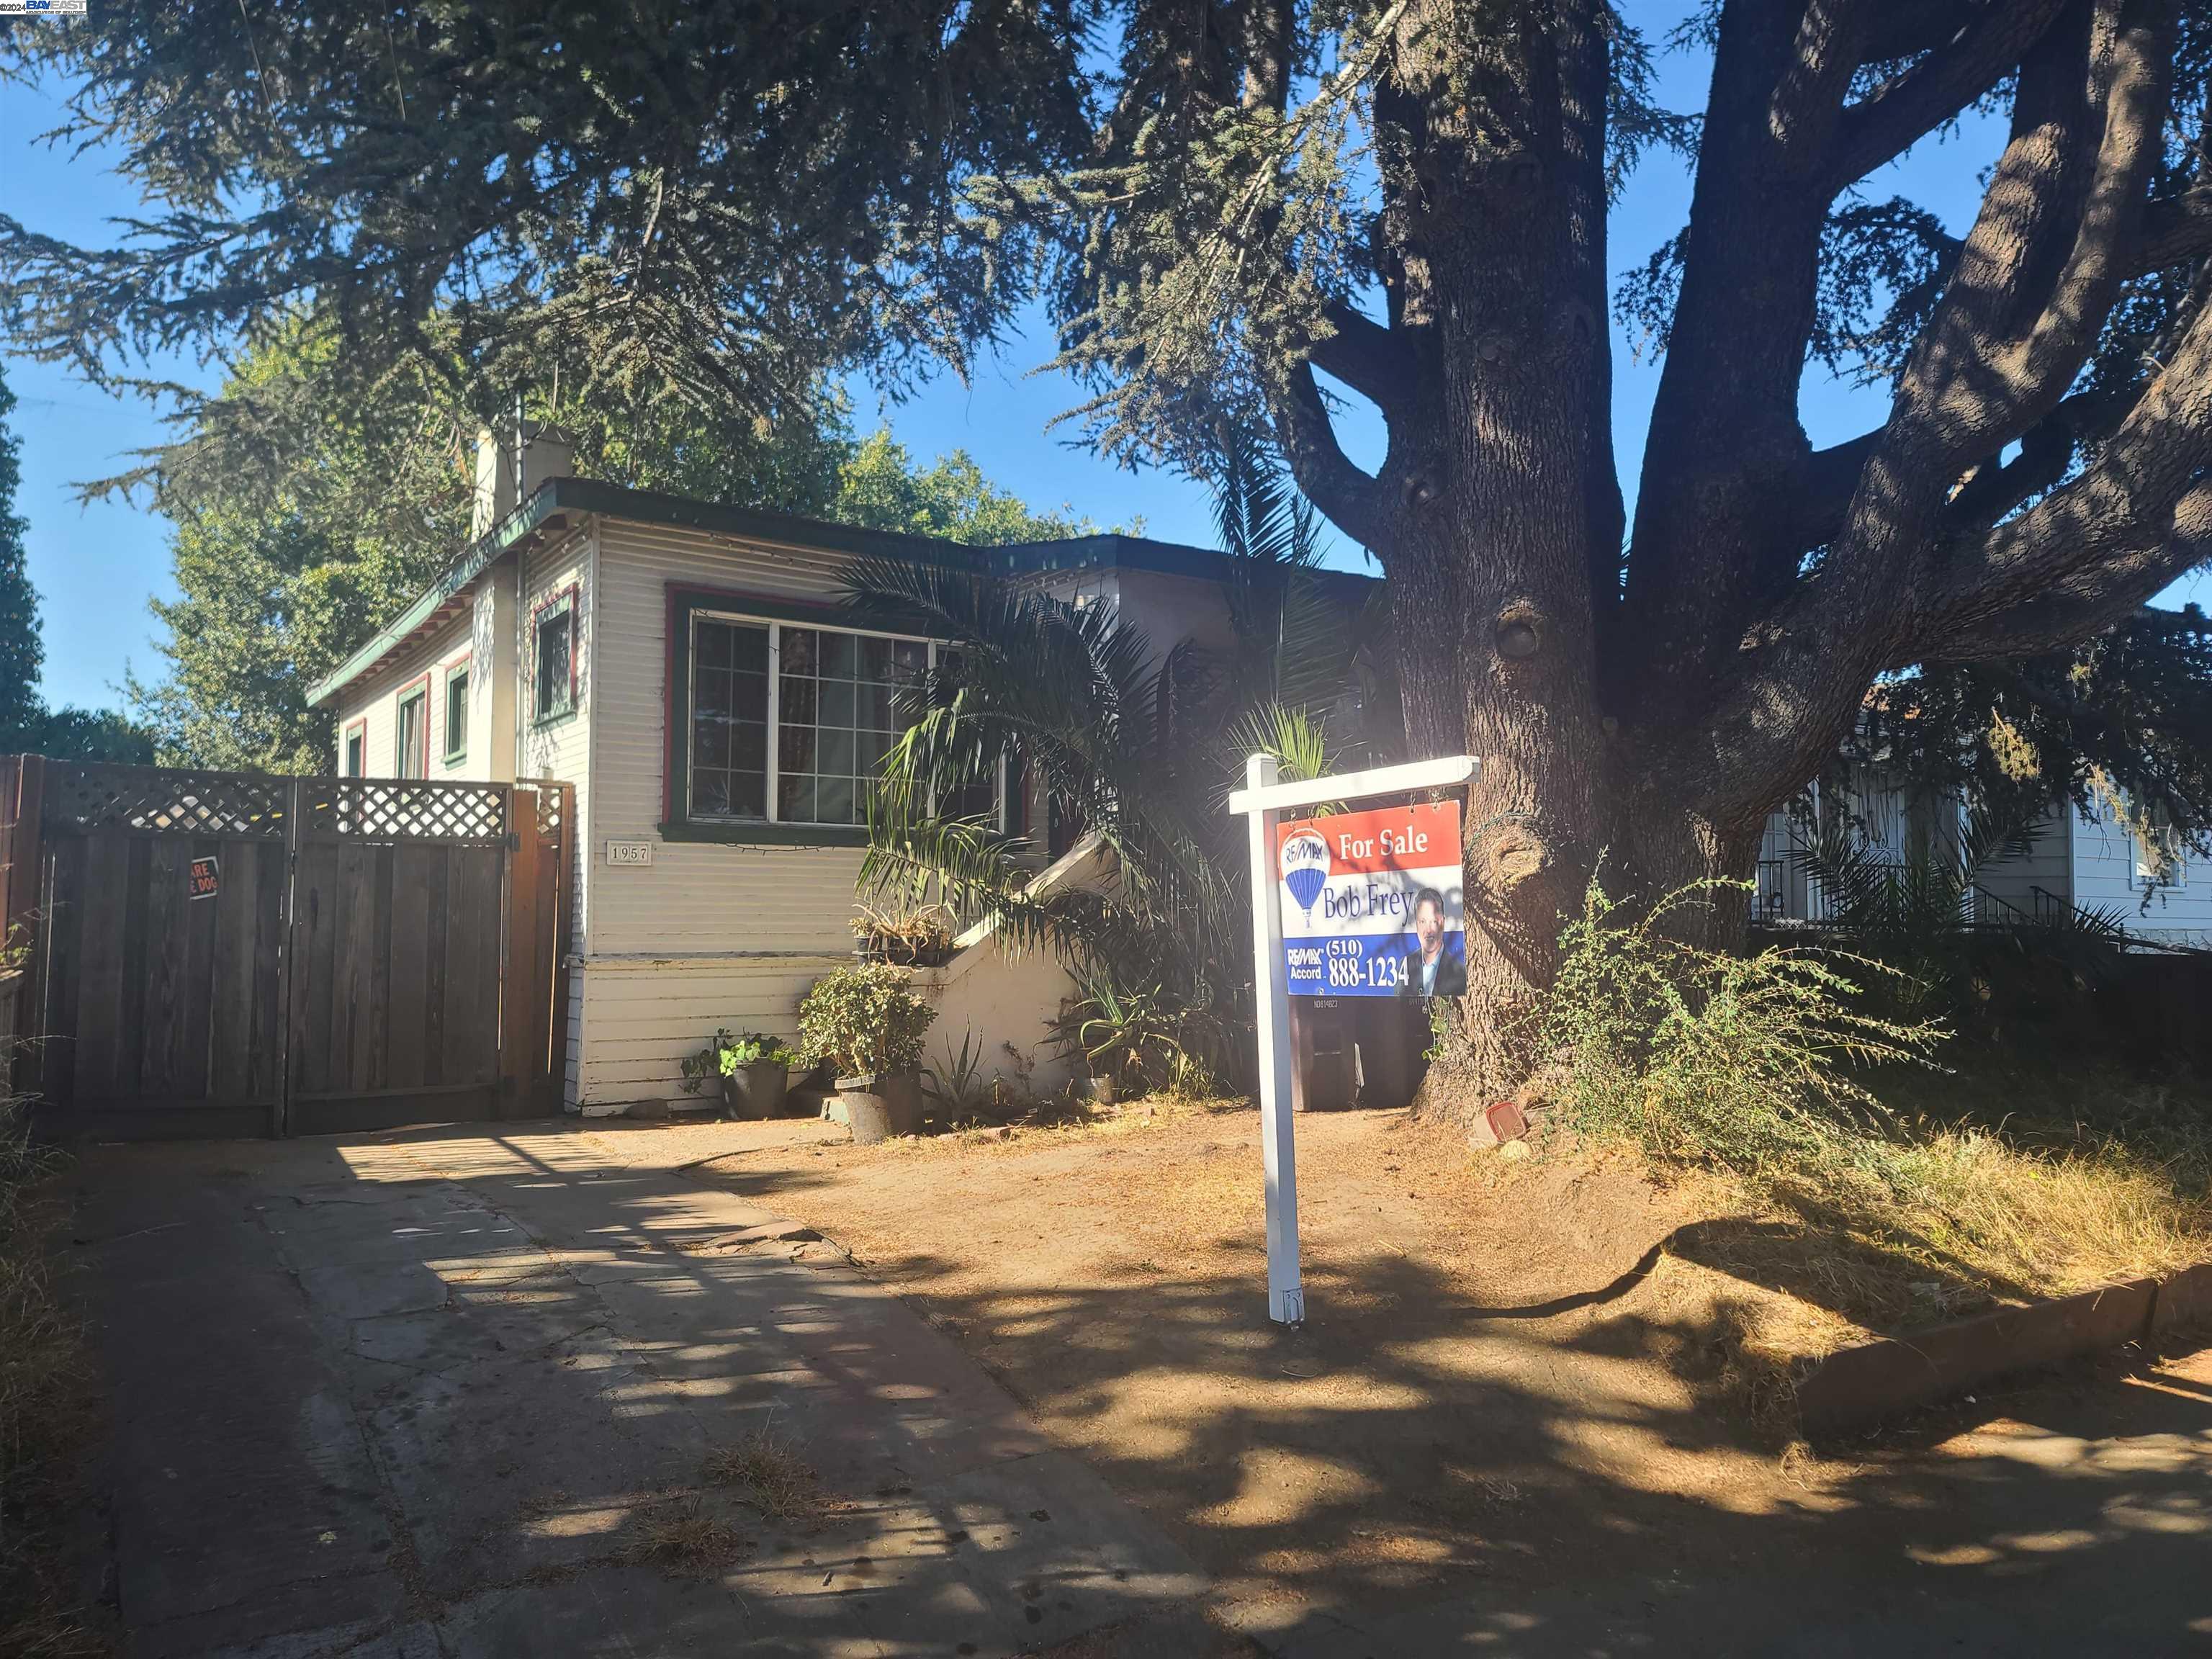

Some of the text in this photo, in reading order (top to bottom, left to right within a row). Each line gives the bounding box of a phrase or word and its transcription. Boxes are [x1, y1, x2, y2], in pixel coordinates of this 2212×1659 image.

[1286, 839, 1323, 863] RE/MAX
[1339, 824, 1429, 860] For Sale
[613, 847, 647, 859] 1957
[198, 876, 218, 891] DOG
[1323, 884, 1414, 927] Bob Frey
[1287, 948, 1322, 966] RE/MAX
[1326, 940, 1363, 958] (510)
[1290, 966, 1321, 980] Accord
[1328, 956, 1410, 986] 888-1234
